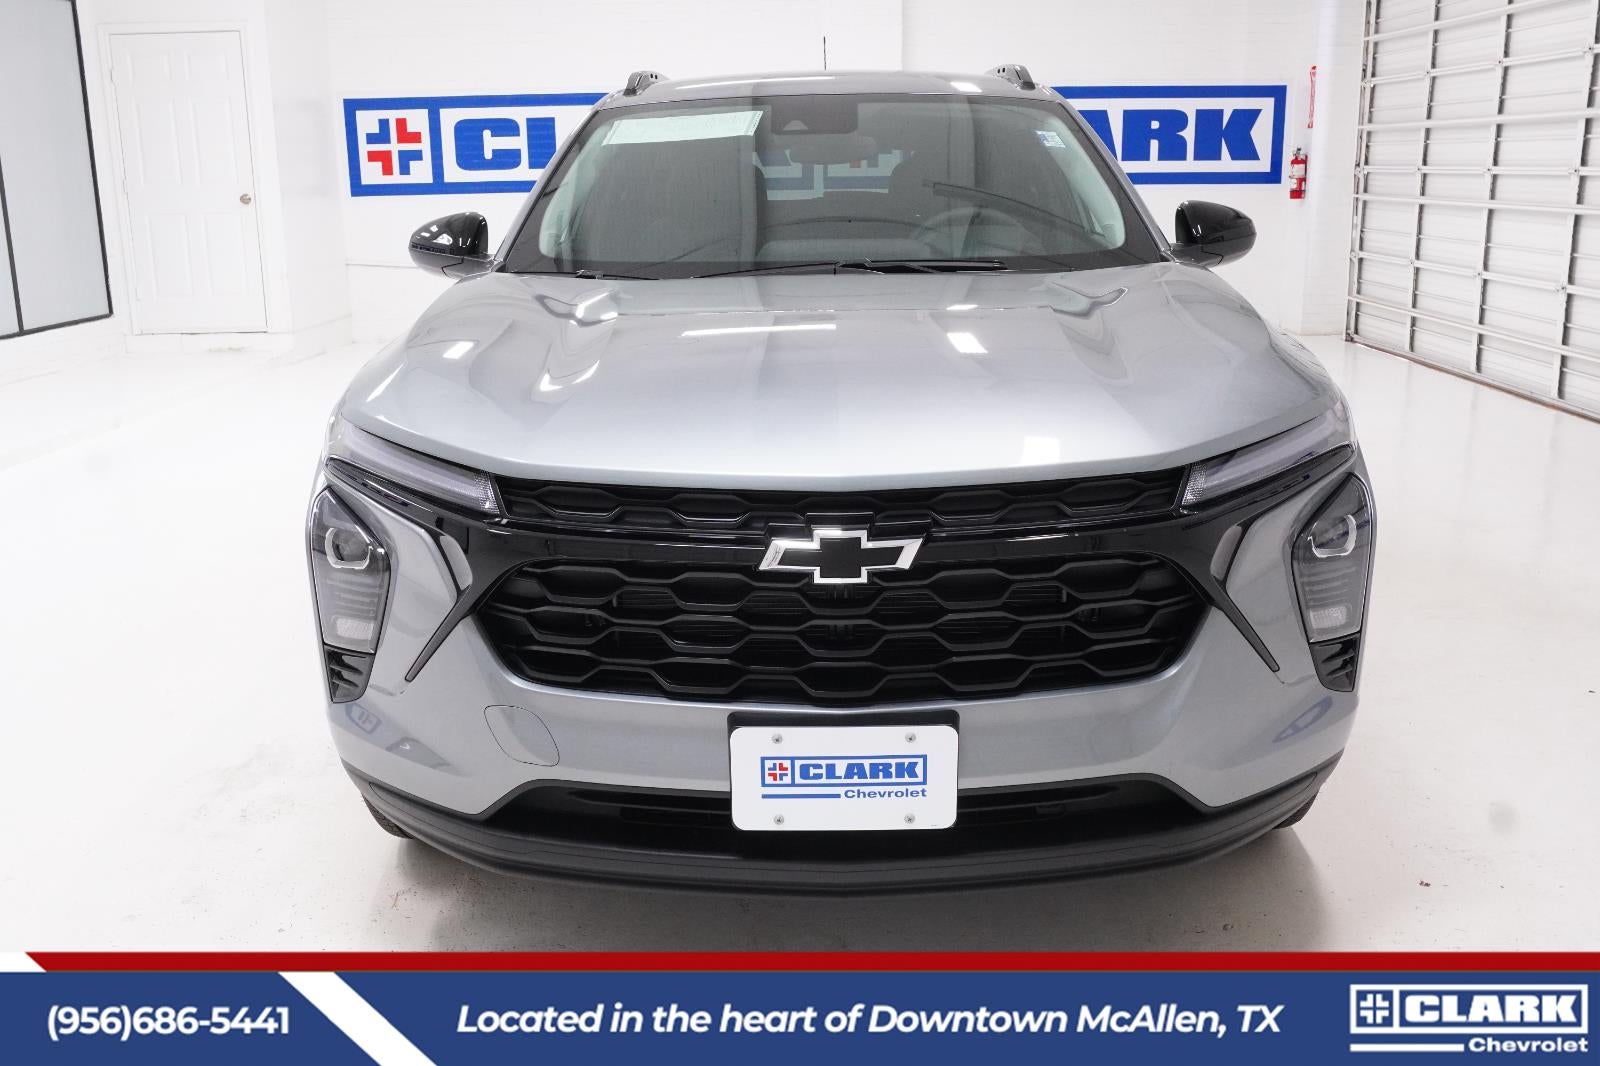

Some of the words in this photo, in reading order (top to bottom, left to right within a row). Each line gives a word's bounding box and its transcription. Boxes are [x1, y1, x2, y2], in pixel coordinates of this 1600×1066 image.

[1080, 109, 1260, 162] RK
[799, 761, 919, 780] CLARK
[844, 787, 928, 799] Chevrolet
